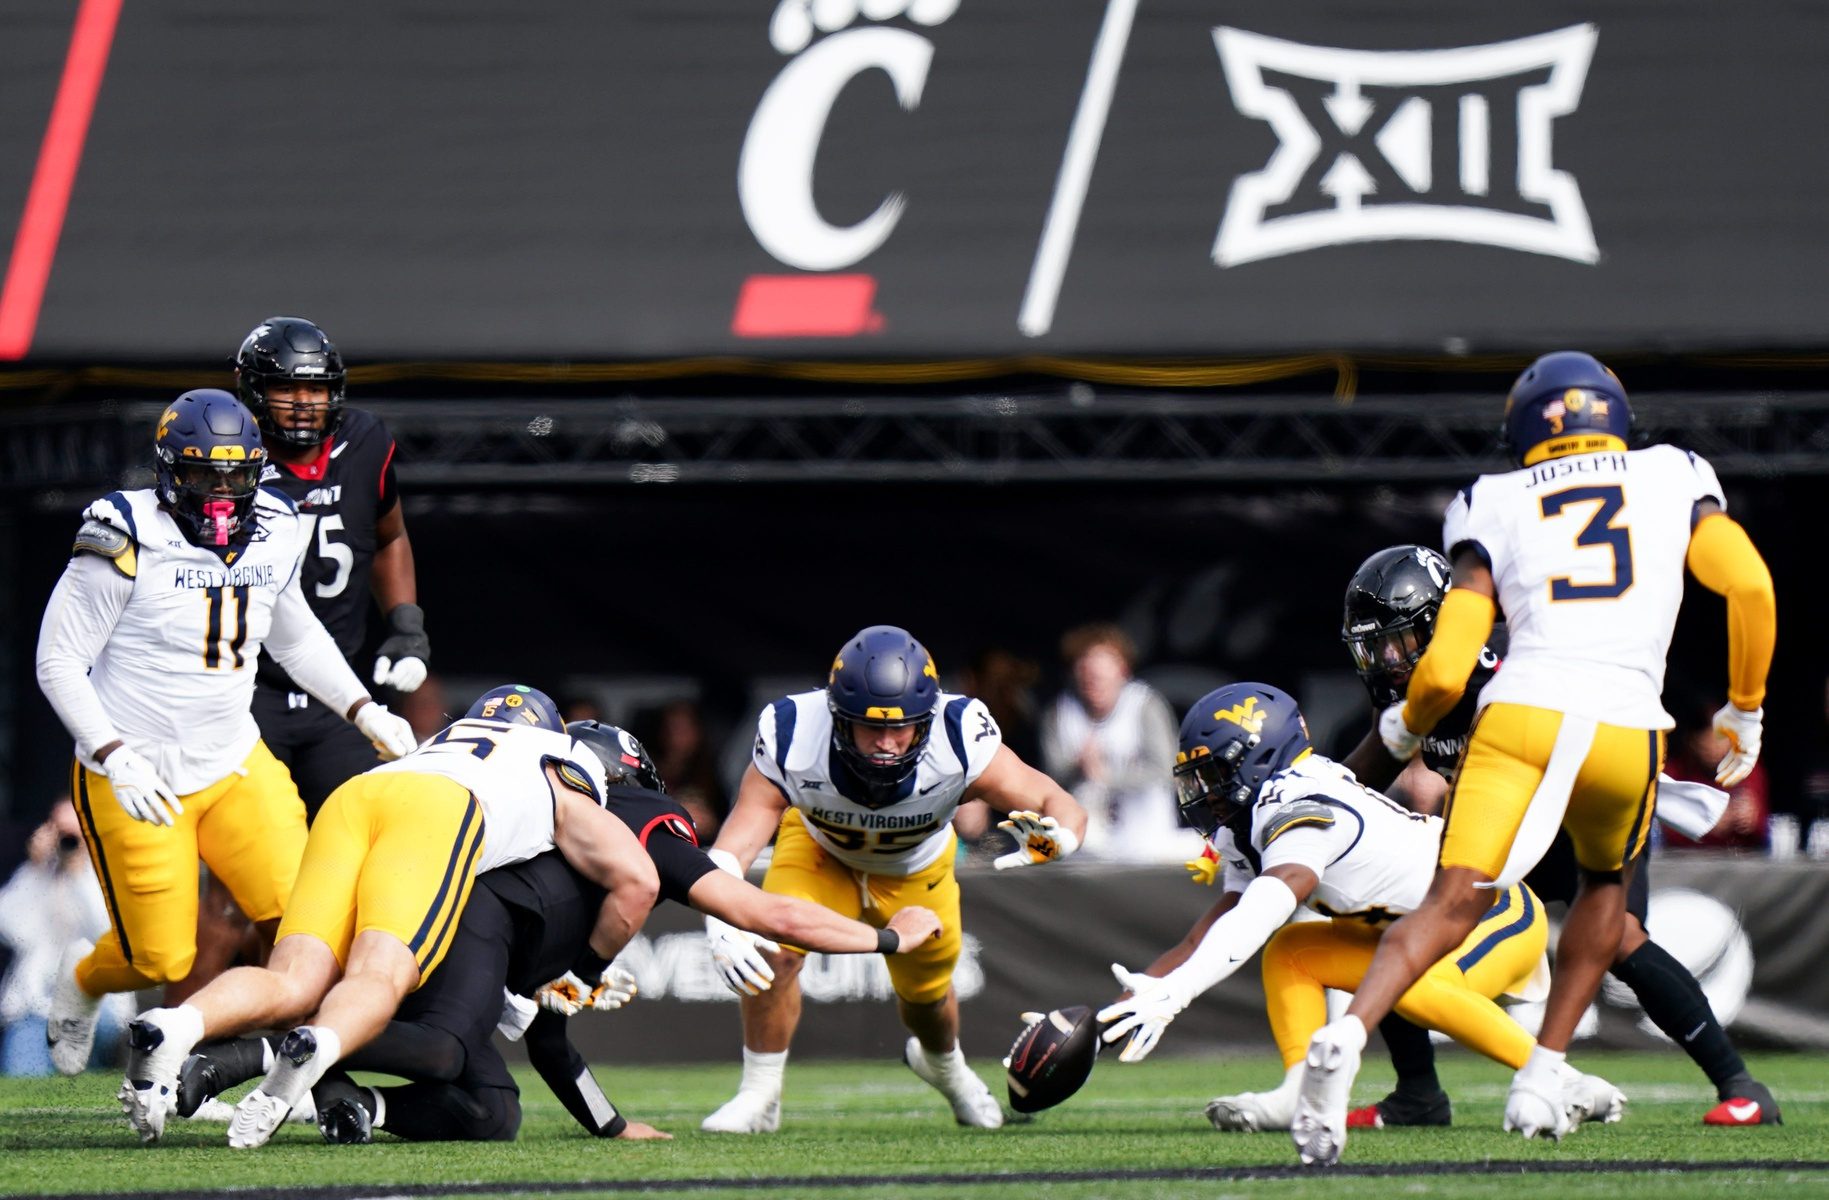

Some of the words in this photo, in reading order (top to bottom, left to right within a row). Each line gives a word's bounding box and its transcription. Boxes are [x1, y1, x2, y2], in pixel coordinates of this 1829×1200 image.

[1539, 483, 1637, 604] 3
[203, 586, 250, 671] 11
[811, 806, 855, 826] WEST
[858, 811, 934, 829] VIRGINIA
